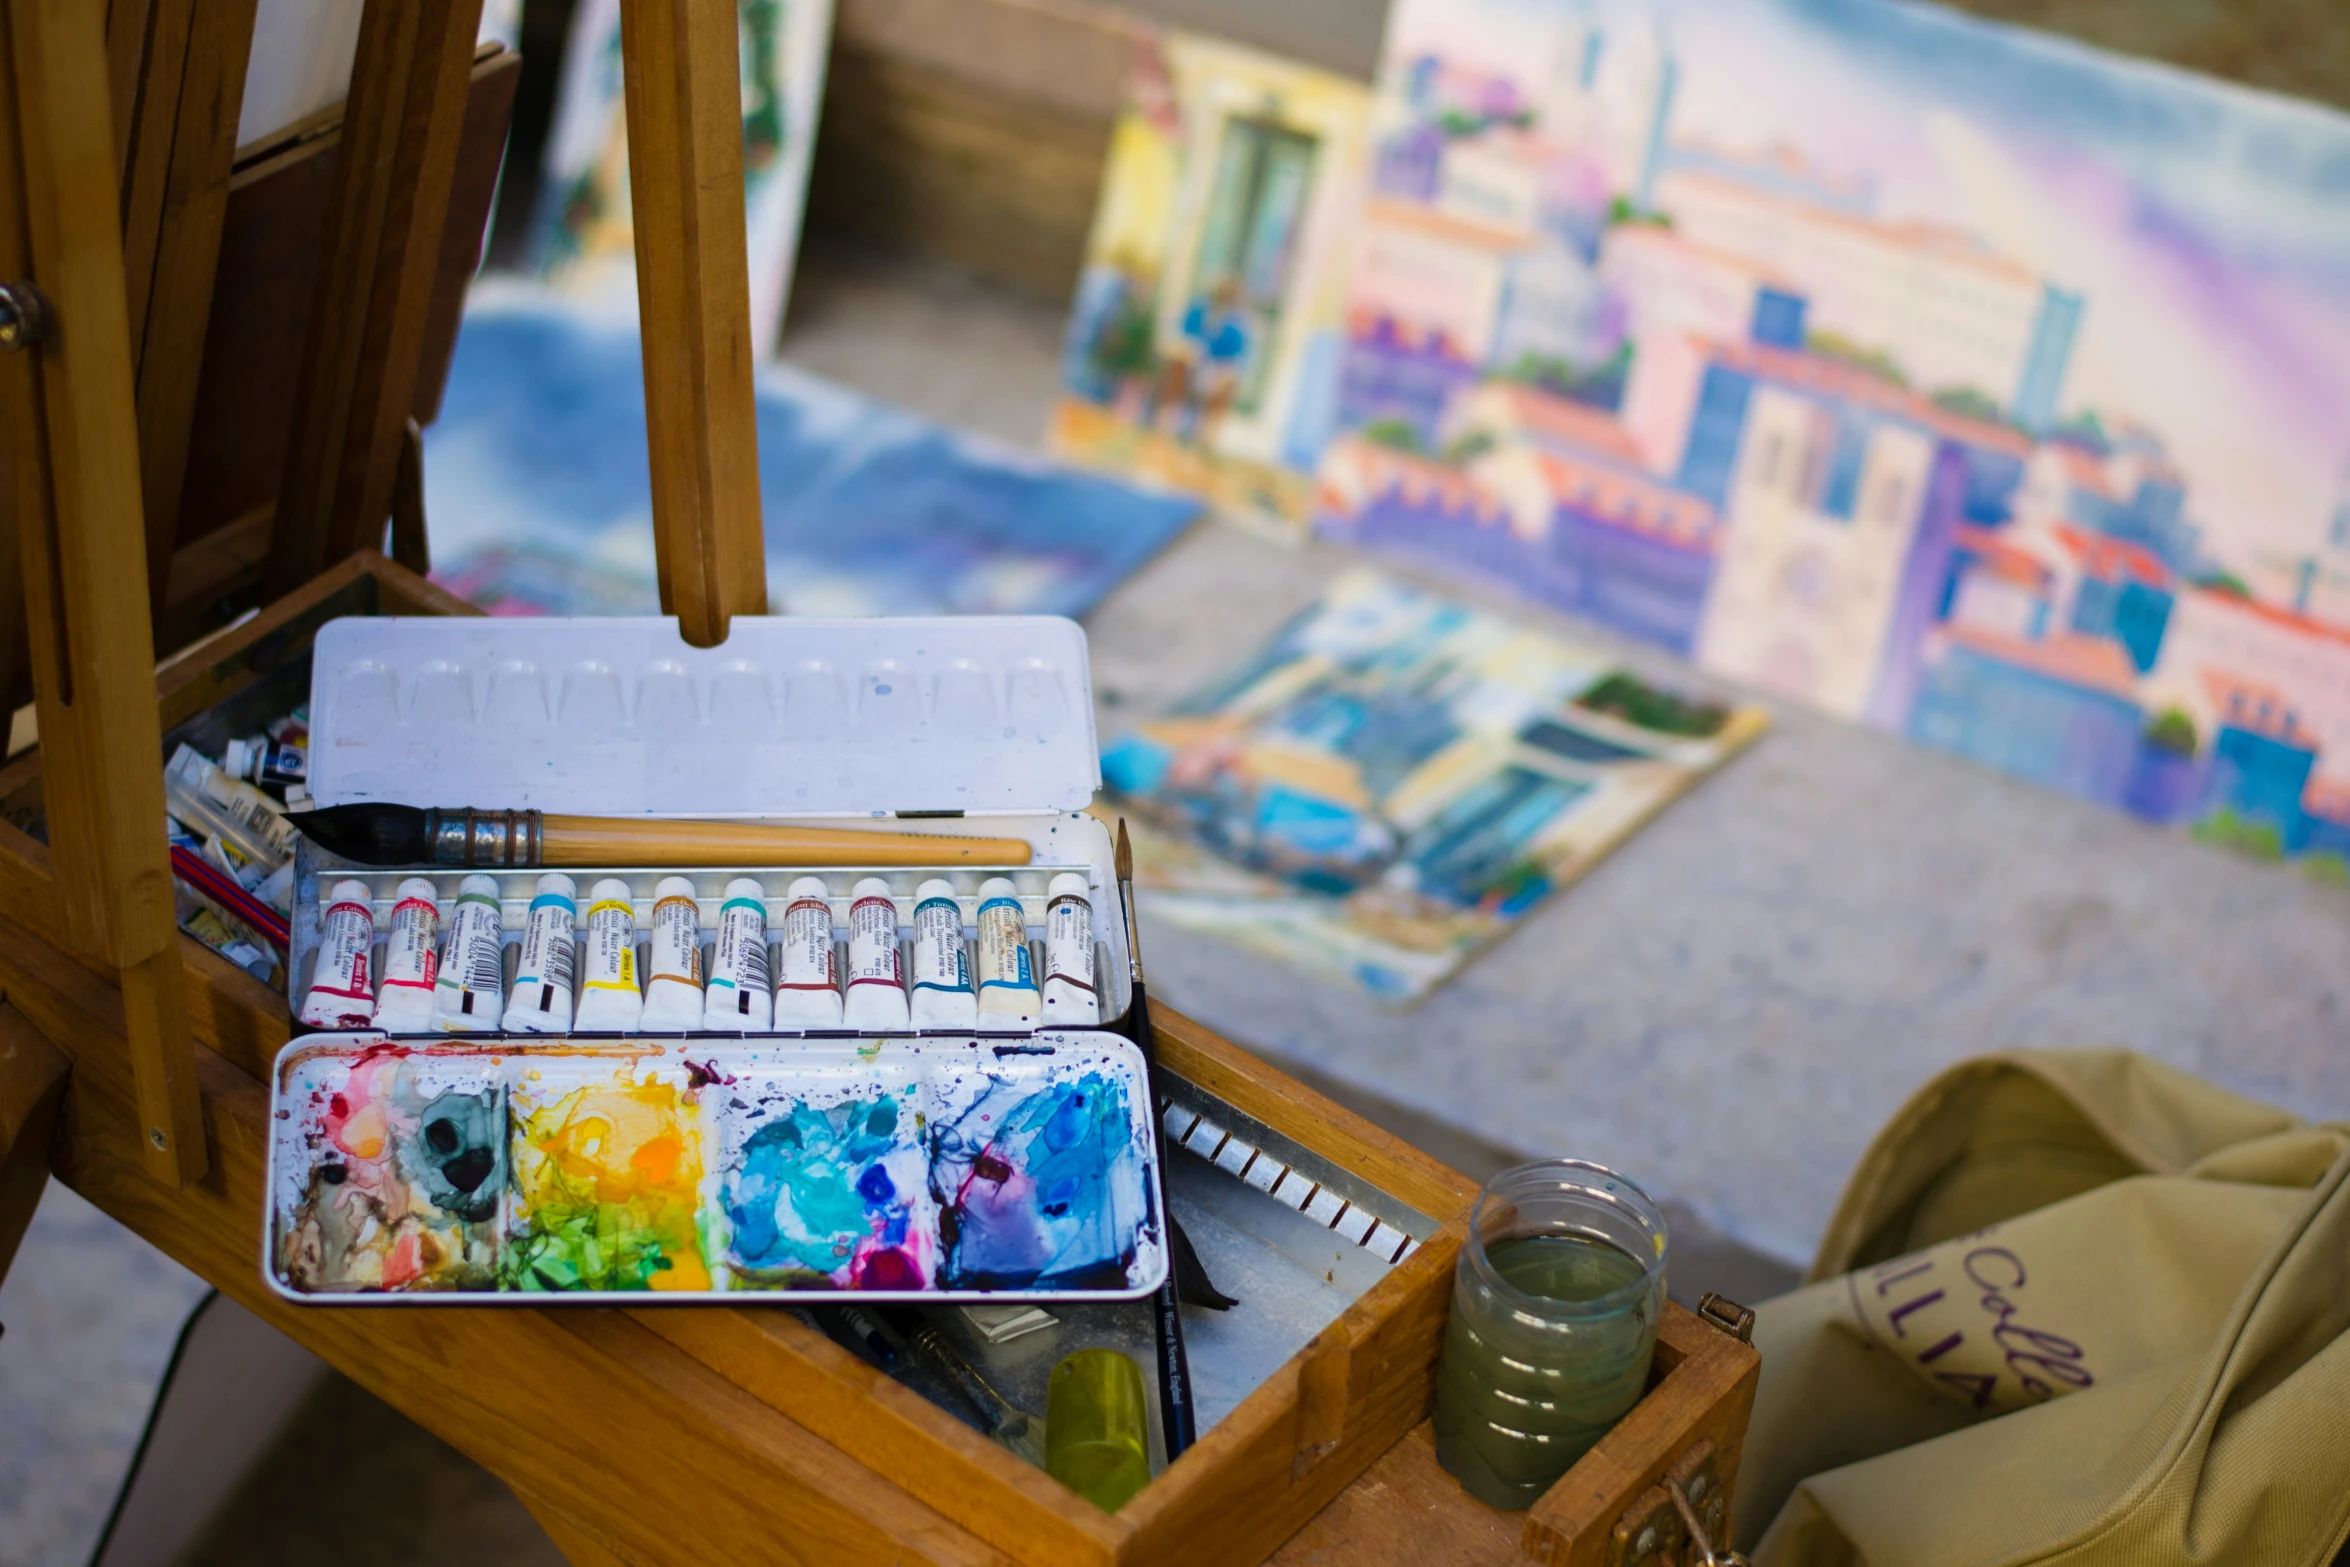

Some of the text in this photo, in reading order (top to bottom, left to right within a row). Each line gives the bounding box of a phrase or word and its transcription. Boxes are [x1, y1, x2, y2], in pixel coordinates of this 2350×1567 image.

[935, 908, 943, 927] Cobalt
[345, 936, 356, 953] Water
[417, 933, 426, 950] Water
[611, 933, 619, 950] Water
[682, 930, 691, 947] Water
[817, 910, 827, 975] Artists' Water Colour
[882, 907, 893, 972] Artists' Water Colour
[936, 928, 944, 956] Turquoise
[945, 909, 957, 976] Artists' Water Colour
[1006, 931, 1014, 947] Water
[341, 956, 353, 979] Colour
[356, 959, 365, 976] Series
[415, 951, 425, 973] Colour
[463, 937, 479, 986] 5004 1442
[544, 938, 558, 979] 5082 3598
[610, 952, 620, 973] Colour
[682, 948, 691, 970] Colour
[736, 940, 748, 983] 5069 4723
[1006, 950, 1016, 973] Colour
[961, 976, 969, 985] AA
[1161, 1282, 1171, 1305] Round
[1164, 1311, 1174, 1336] Winsor
[1169, 1375, 1183, 1404] England
